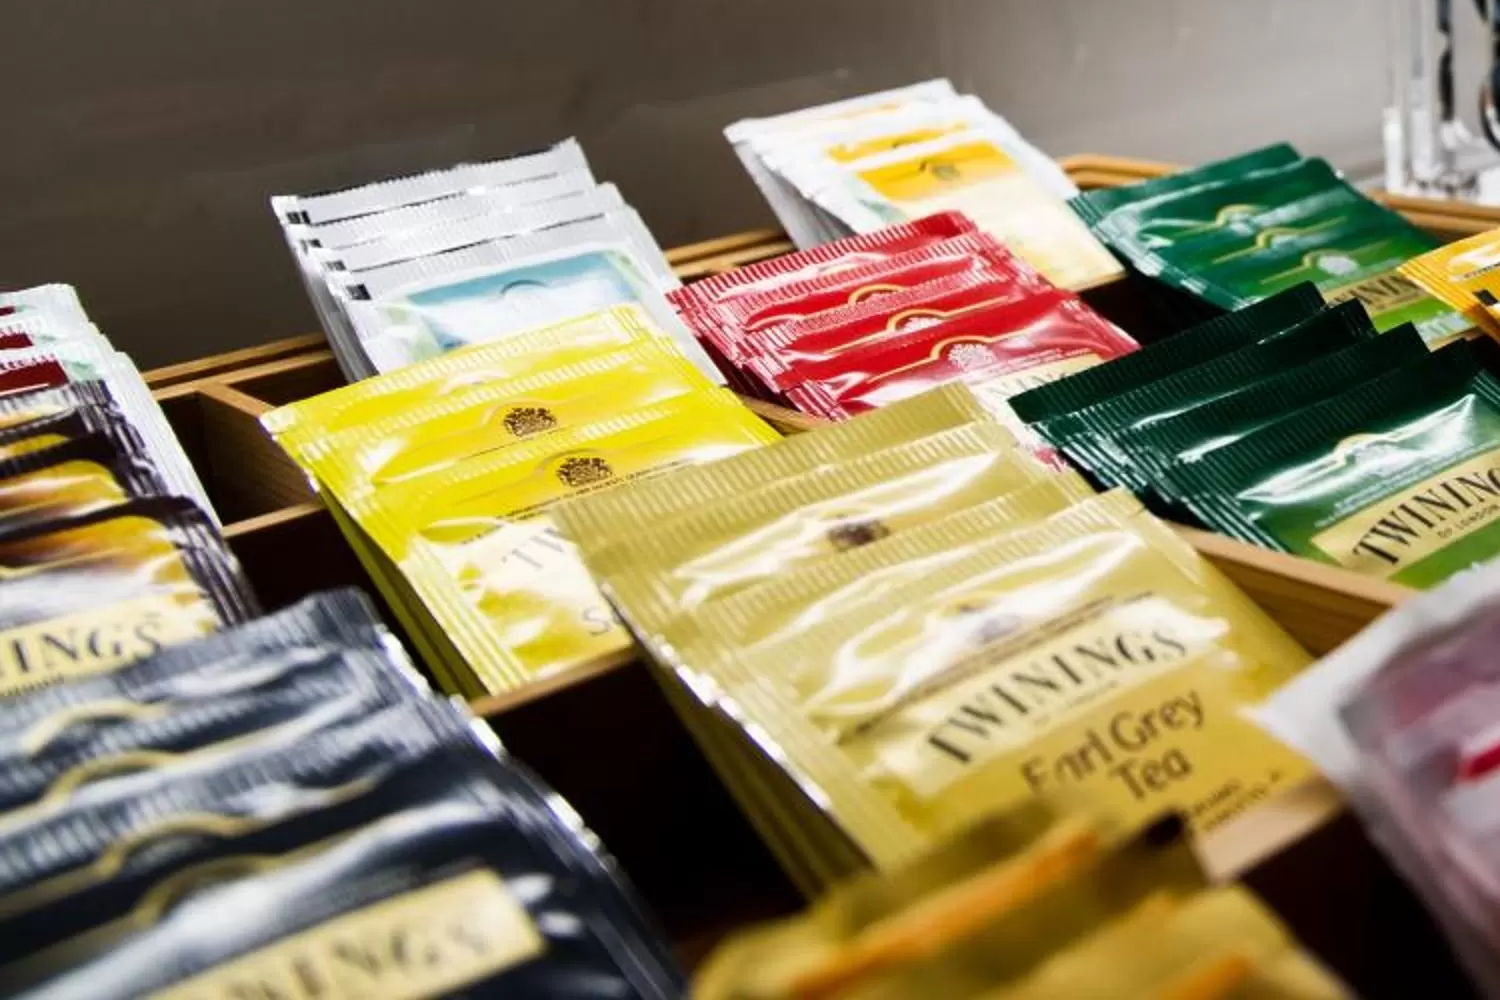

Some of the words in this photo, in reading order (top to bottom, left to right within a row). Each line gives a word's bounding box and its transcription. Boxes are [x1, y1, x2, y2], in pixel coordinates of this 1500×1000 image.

[927, 629, 1187, 764] TWININGS
[1108, 690, 1206, 754] Grey
[1111, 747, 1194, 801] Tea
